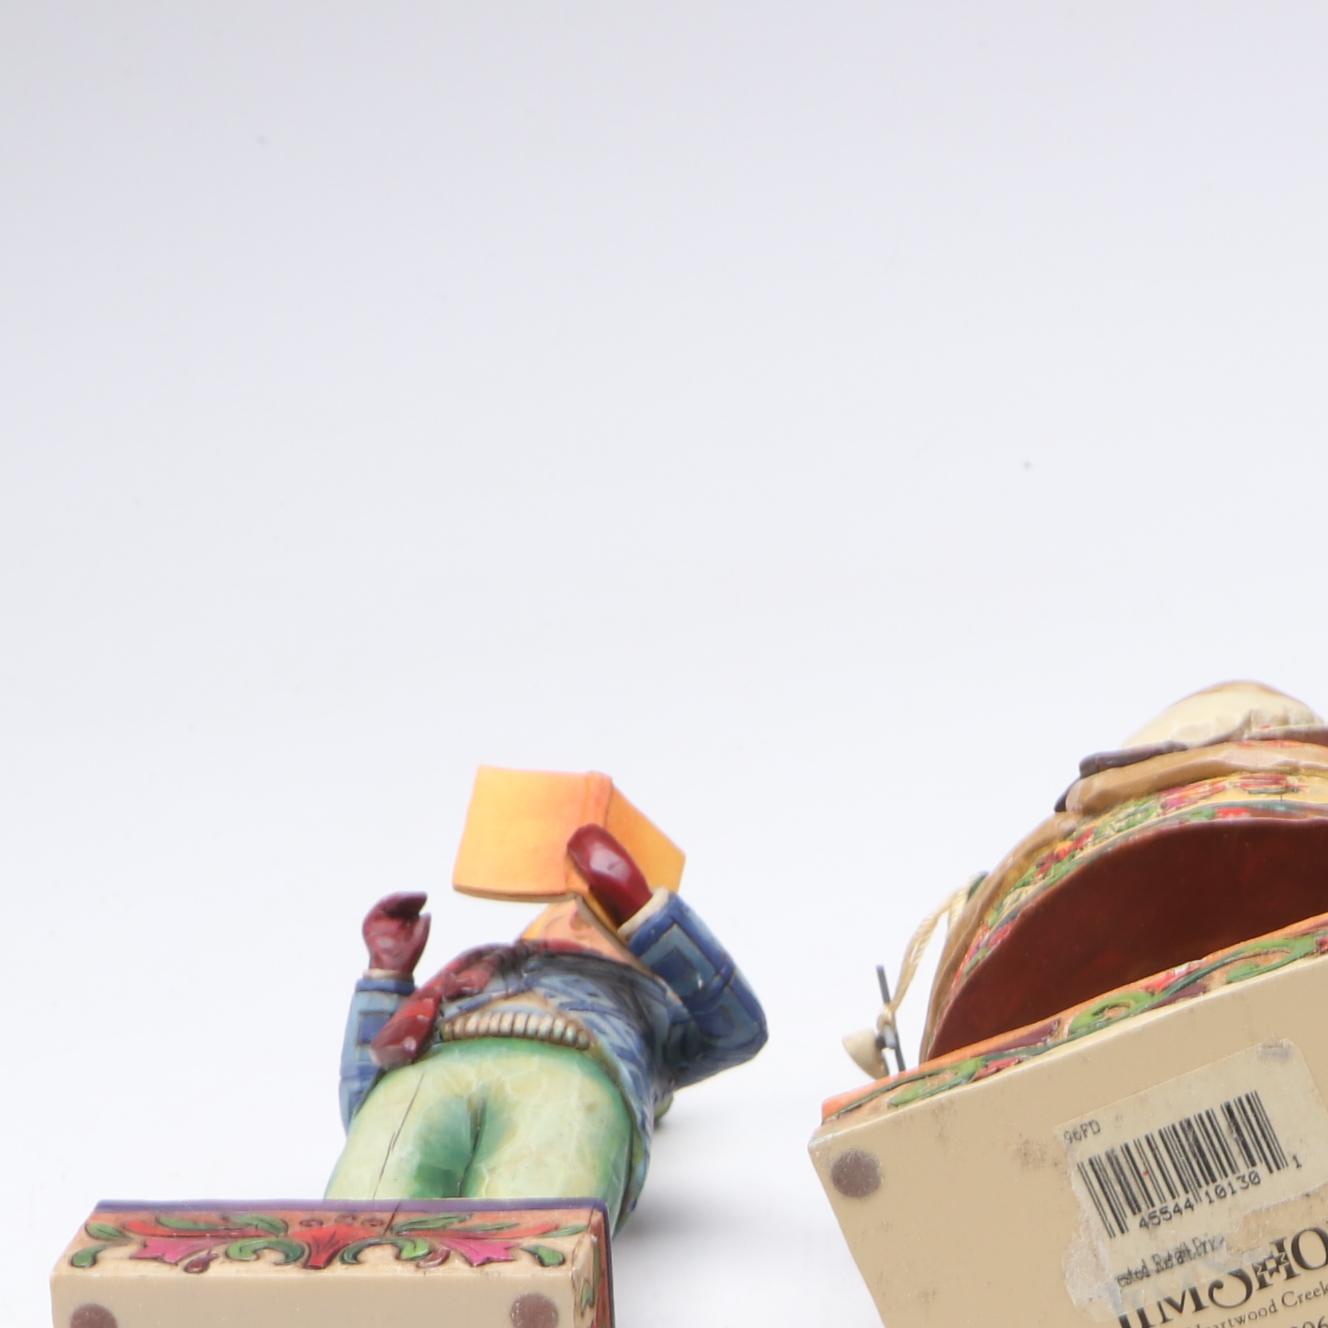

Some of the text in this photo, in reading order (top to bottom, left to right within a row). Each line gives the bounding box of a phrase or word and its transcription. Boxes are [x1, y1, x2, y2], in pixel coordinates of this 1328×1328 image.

[1139, 1154, 1303, 1230] 45544 10130 1
